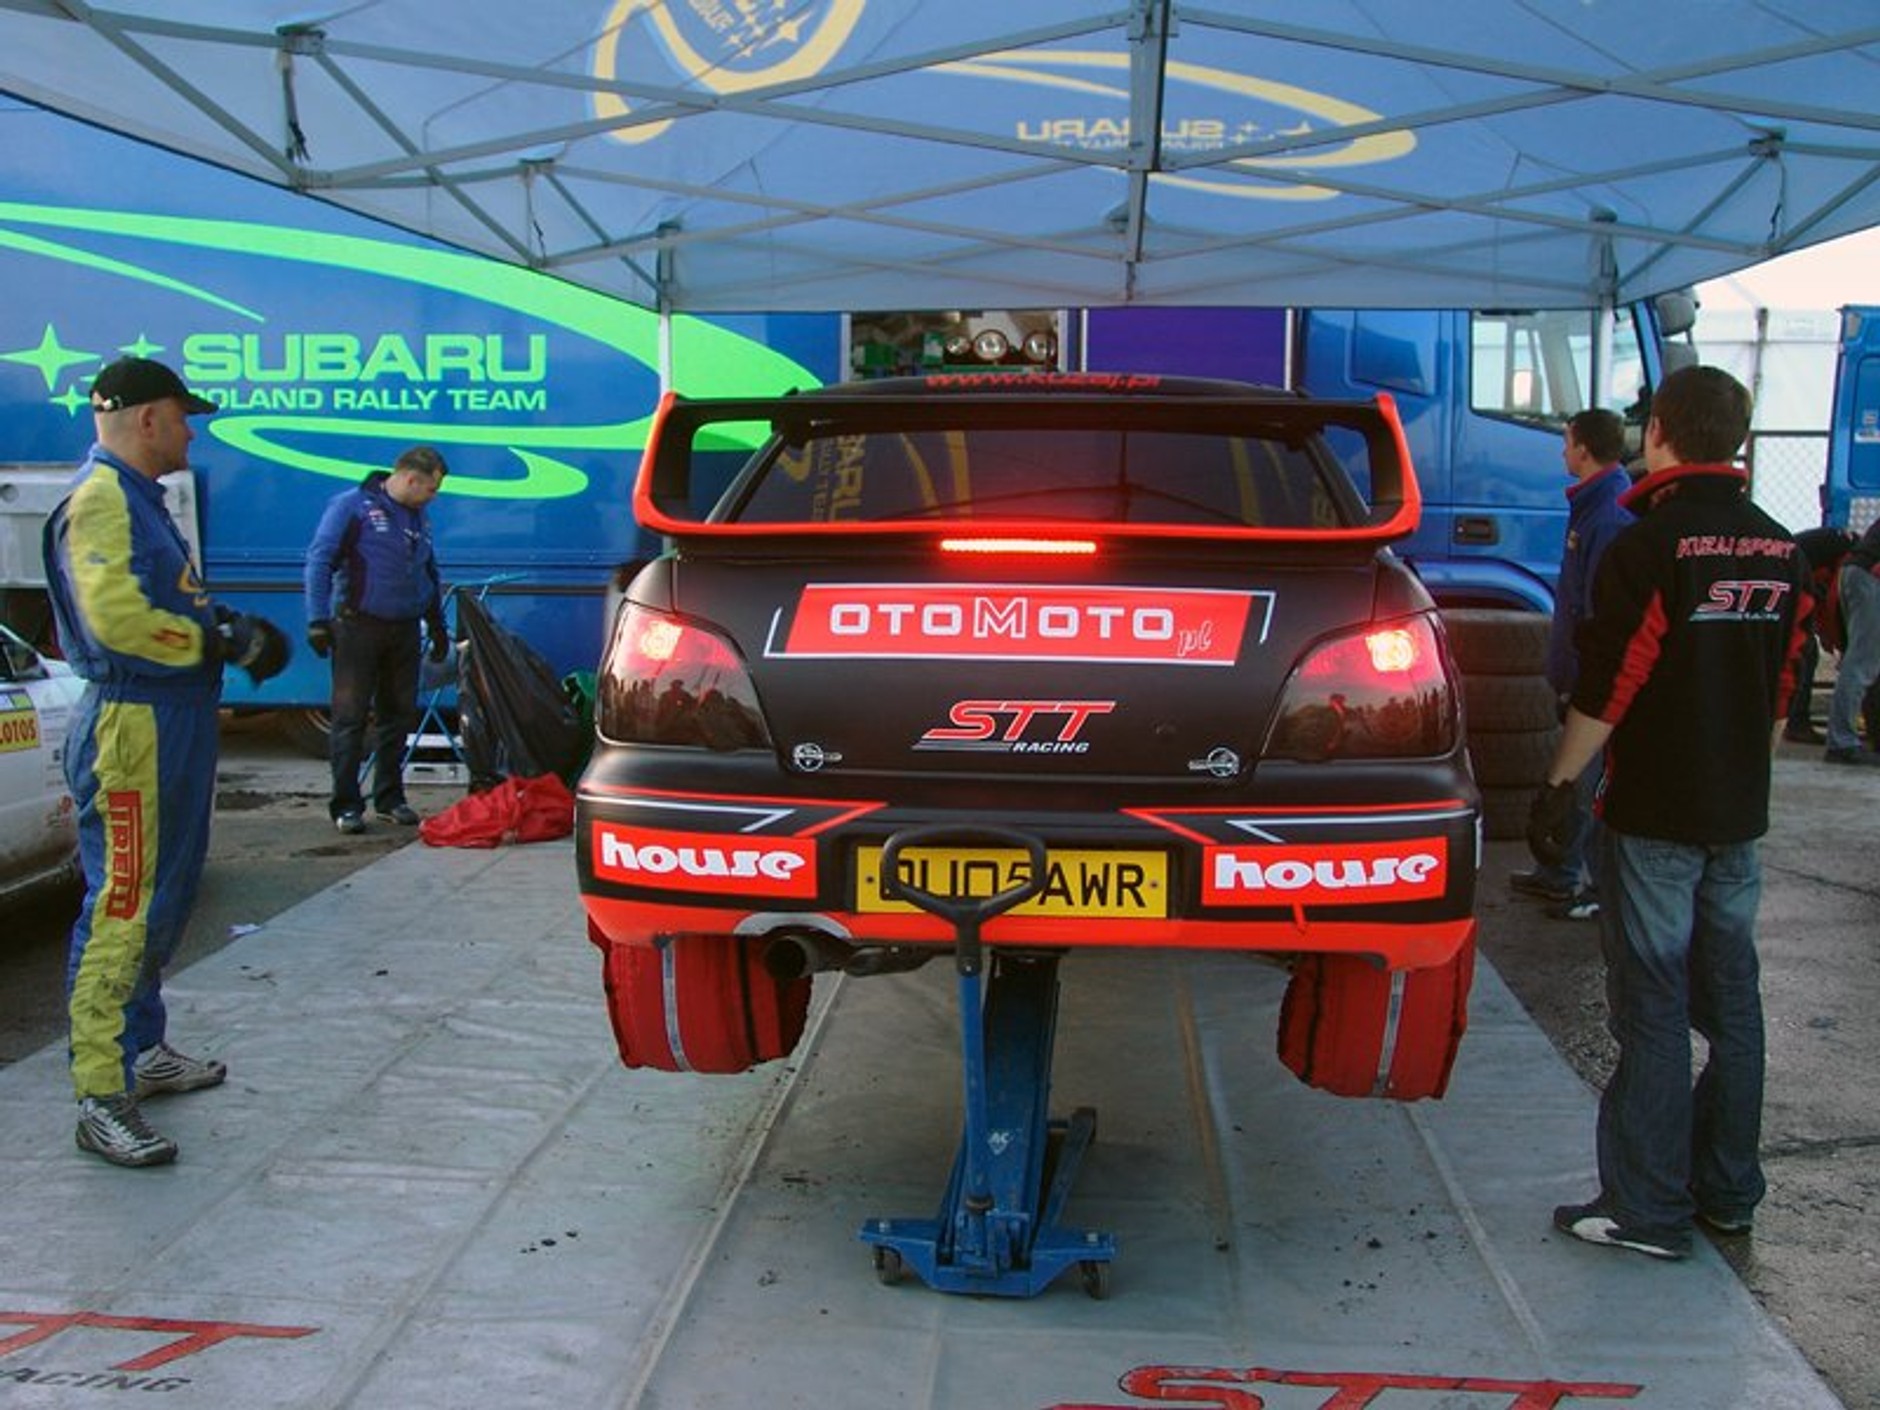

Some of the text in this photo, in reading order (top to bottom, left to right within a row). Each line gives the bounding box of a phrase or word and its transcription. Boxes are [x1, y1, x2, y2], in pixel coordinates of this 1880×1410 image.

[183, 333, 547, 382] SUBARU
[333, 388, 438, 411] RALLY
[446, 389, 547, 411] TEAM
[1735, 537, 1797, 560] SPORT
[1695, 580, 1791, 613] STT
[830, 597, 1174, 640] OTOMOTO
[0, 718, 37, 744] OTOS
[920, 700, 1117, 742] STT
[1012, 742, 1091, 754] RACING
[601, 831, 806, 881] house
[1214, 853, 1439, 889] house
[0, 1367, 192, 1392] ACING
